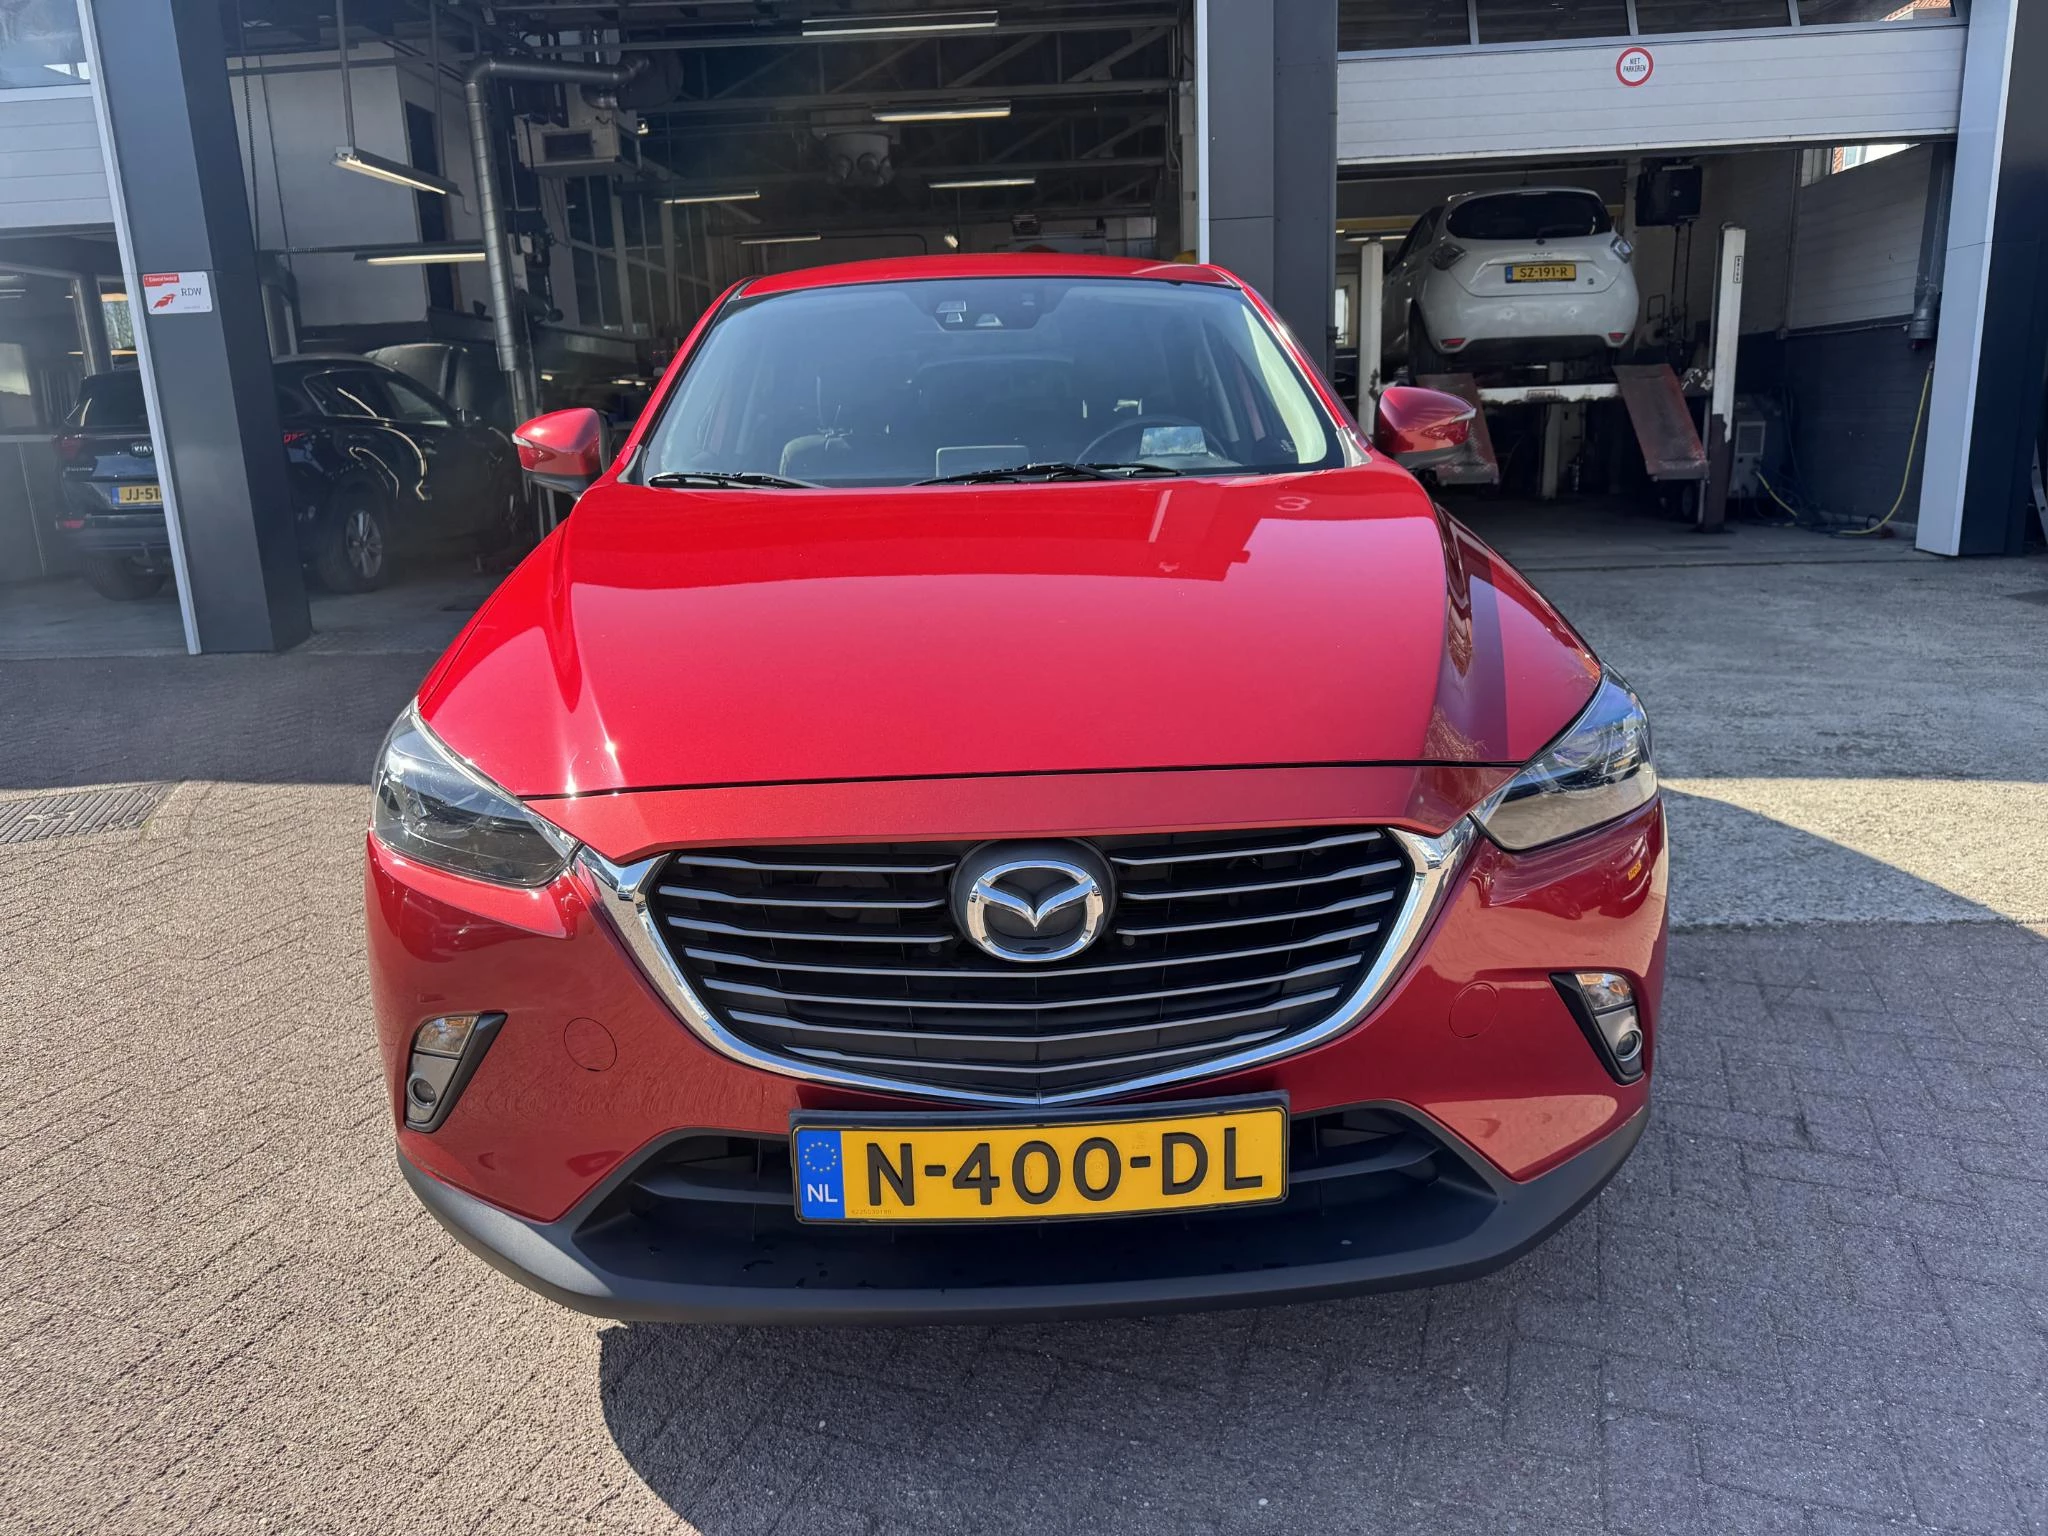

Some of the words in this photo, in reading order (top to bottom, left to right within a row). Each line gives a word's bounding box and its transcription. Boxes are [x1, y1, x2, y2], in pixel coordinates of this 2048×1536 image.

[1520, 267, 1568, 278] SZ-191-R
[181, 288, 201, 296] RDW
[126, 488, 161, 501] JJ-51
[866, 1126, 1263, 1206] N-400-DL
[807, 1183, 838, 1202] NL
